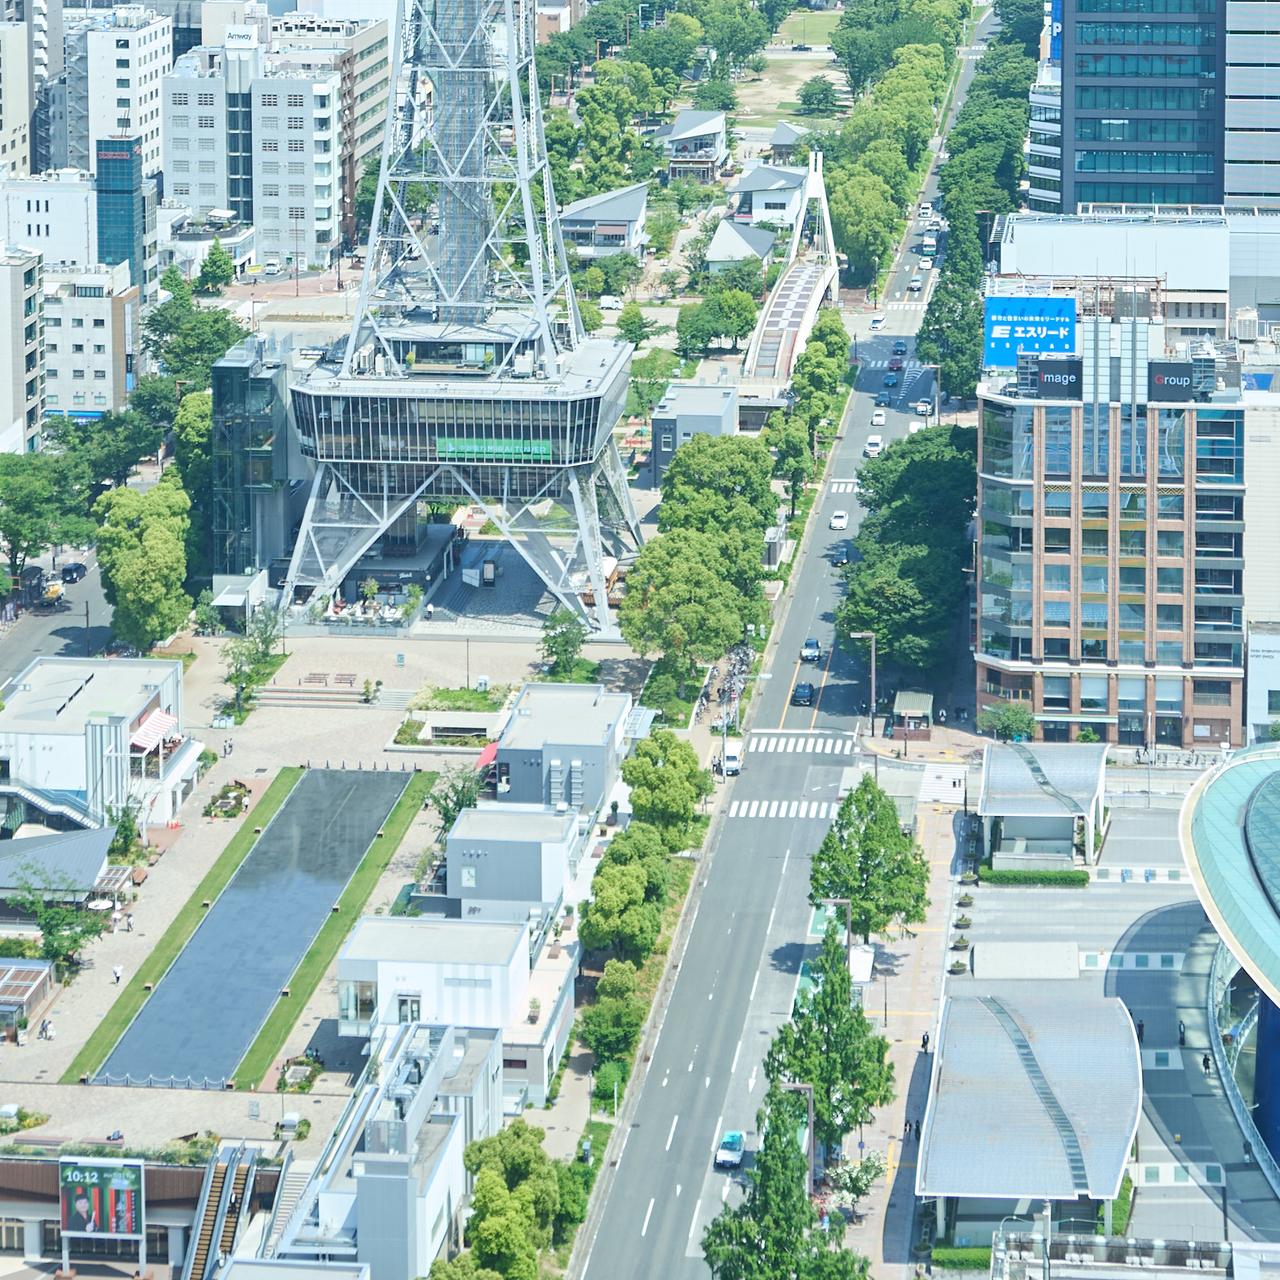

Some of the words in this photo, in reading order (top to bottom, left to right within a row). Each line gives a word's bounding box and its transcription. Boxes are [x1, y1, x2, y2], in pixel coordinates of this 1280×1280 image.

[227, 32, 252, 40] Amway
[1053, 22, 1062, 37] P
[1014, 326, 1069, 339] エスリード
[1041, 372, 1076, 385] Image
[1155, 374, 1190, 387] Group
[67, 1170, 98, 1183] 10:12
